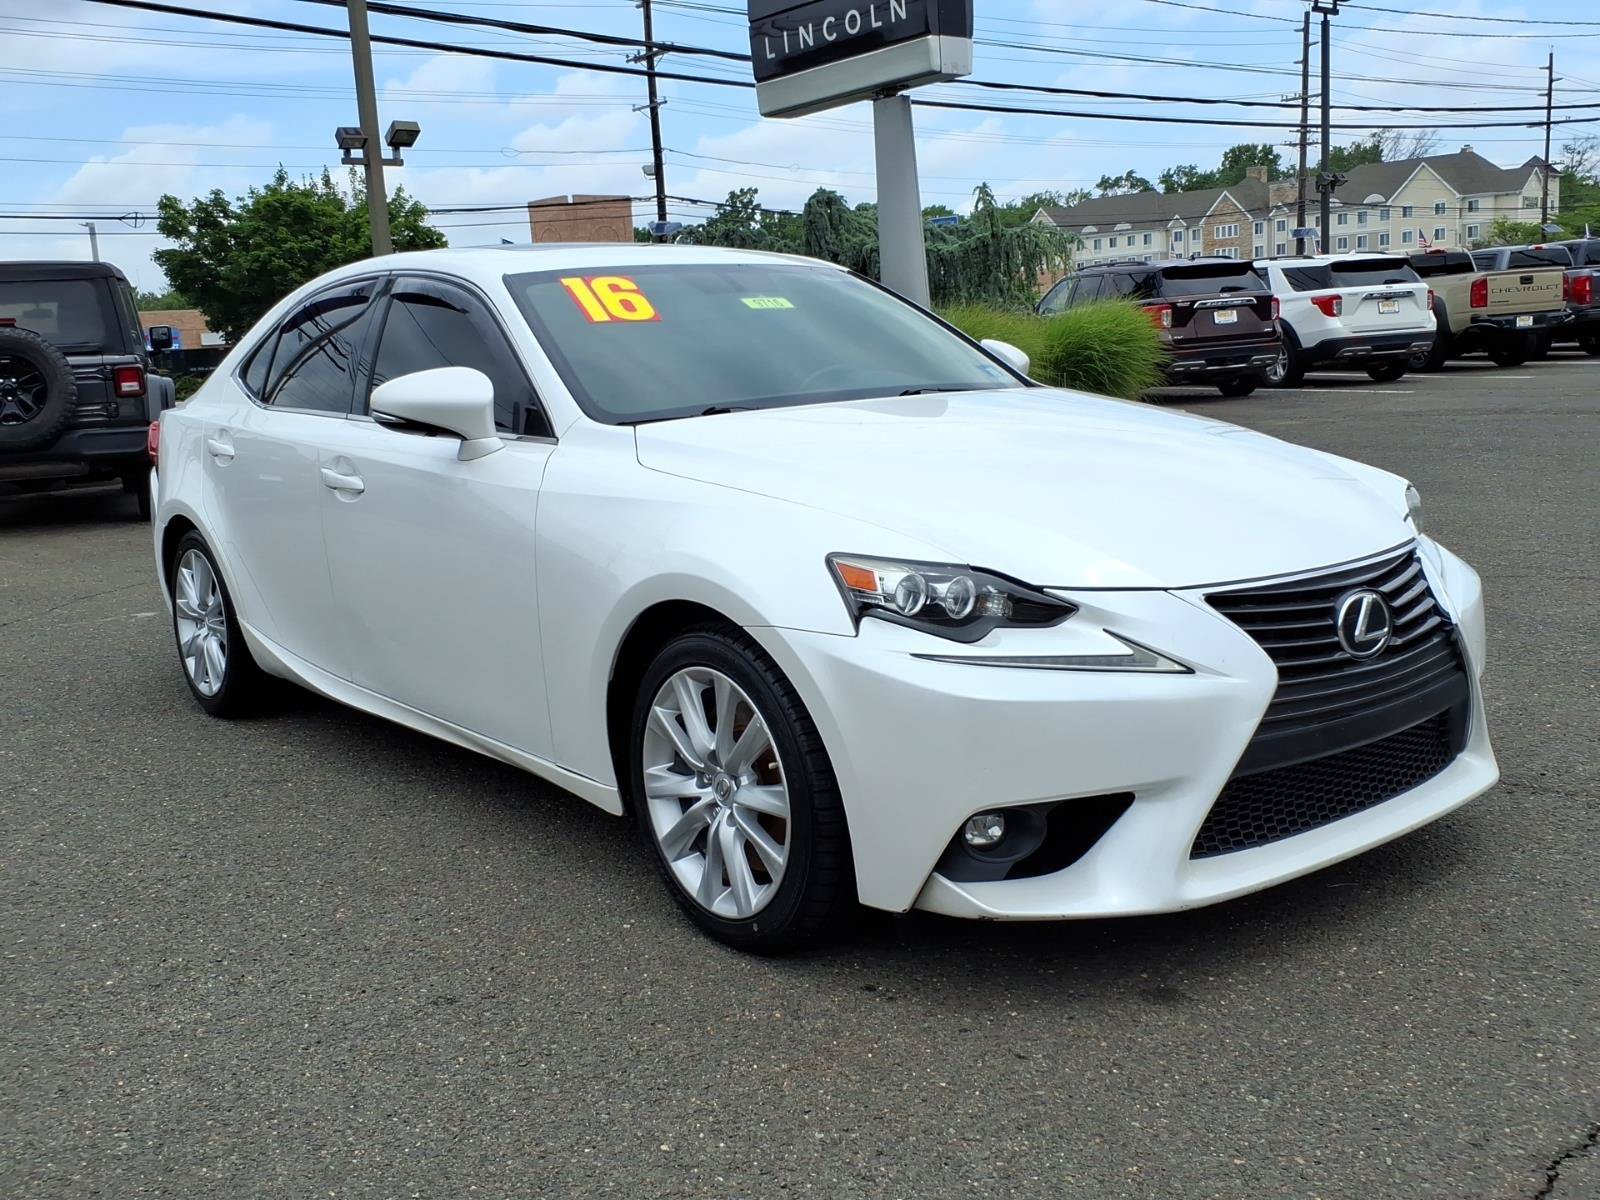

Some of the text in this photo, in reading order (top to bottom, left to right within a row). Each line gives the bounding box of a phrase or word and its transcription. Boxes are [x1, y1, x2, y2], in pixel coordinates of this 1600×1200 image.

[764, 0, 906, 59] LINCOLN
[560, 276, 656, 322] 16
[1491, 283, 1560, 294] CHEVROLET
